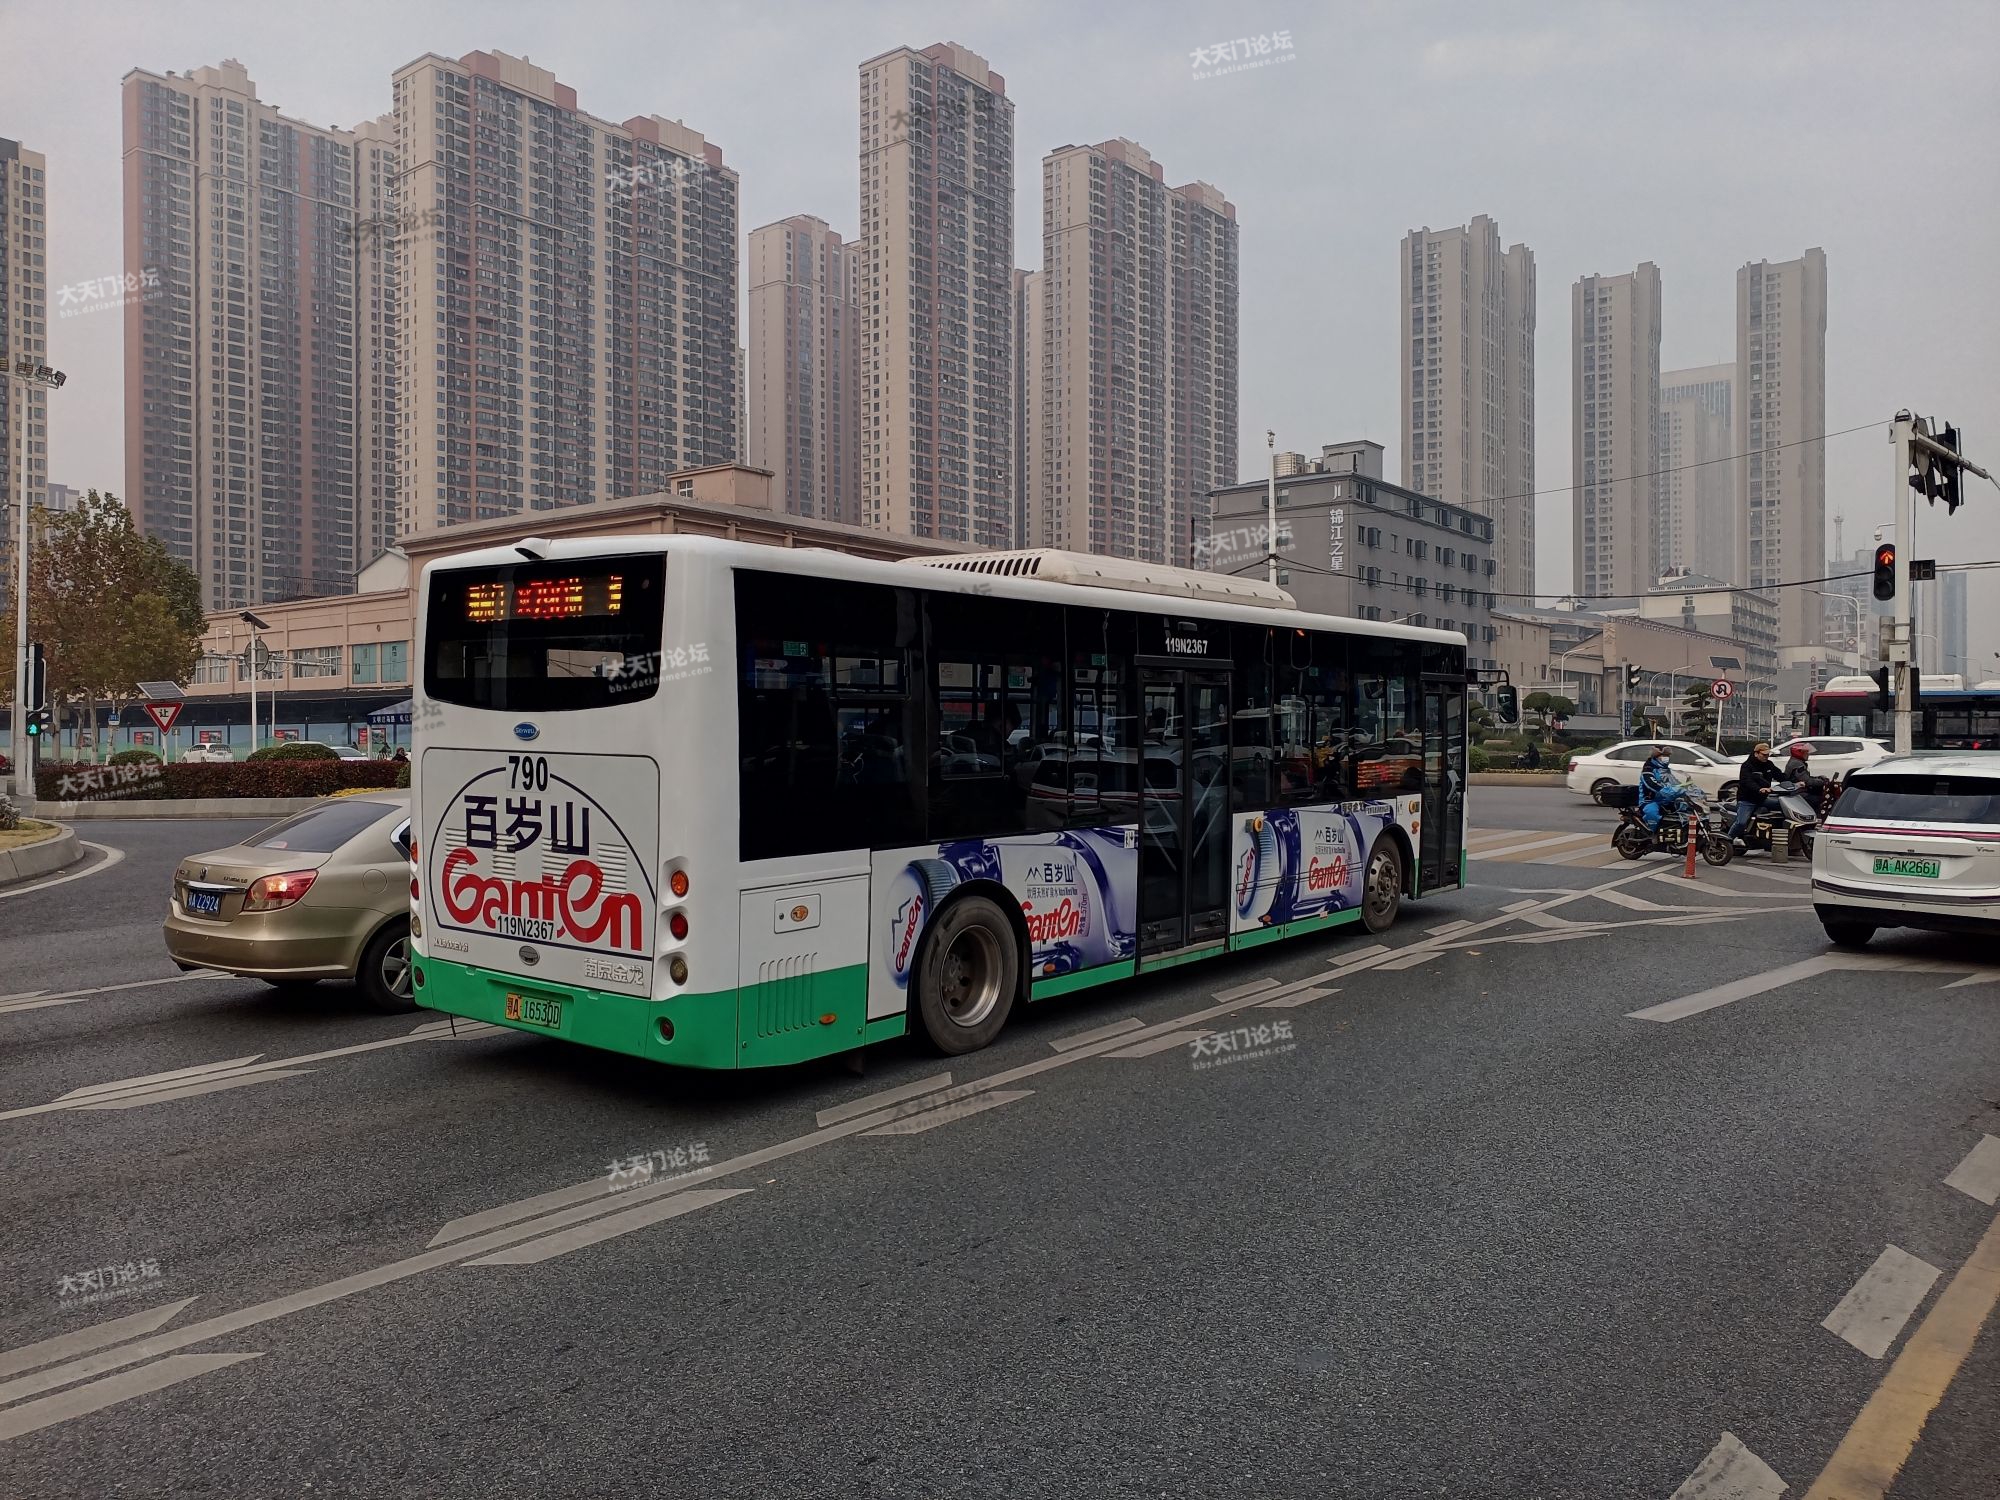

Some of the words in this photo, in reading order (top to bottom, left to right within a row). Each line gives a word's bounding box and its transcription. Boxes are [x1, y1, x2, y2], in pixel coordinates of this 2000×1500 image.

[1329, 508, 1344, 571] 锦江之星
[1165, 637, 1208, 654] 119N2367
[159, 709, 169, 718] 让
[508, 755, 548, 791] 790
[464, 795, 589, 856] 百岁山
[1325, 826, 1344, 843] 百岁山
[1044, 862, 1074, 883] 百岁山
[497, 915, 554, 940] 119N2367
[584, 957, 644, 985] 南京金龙
